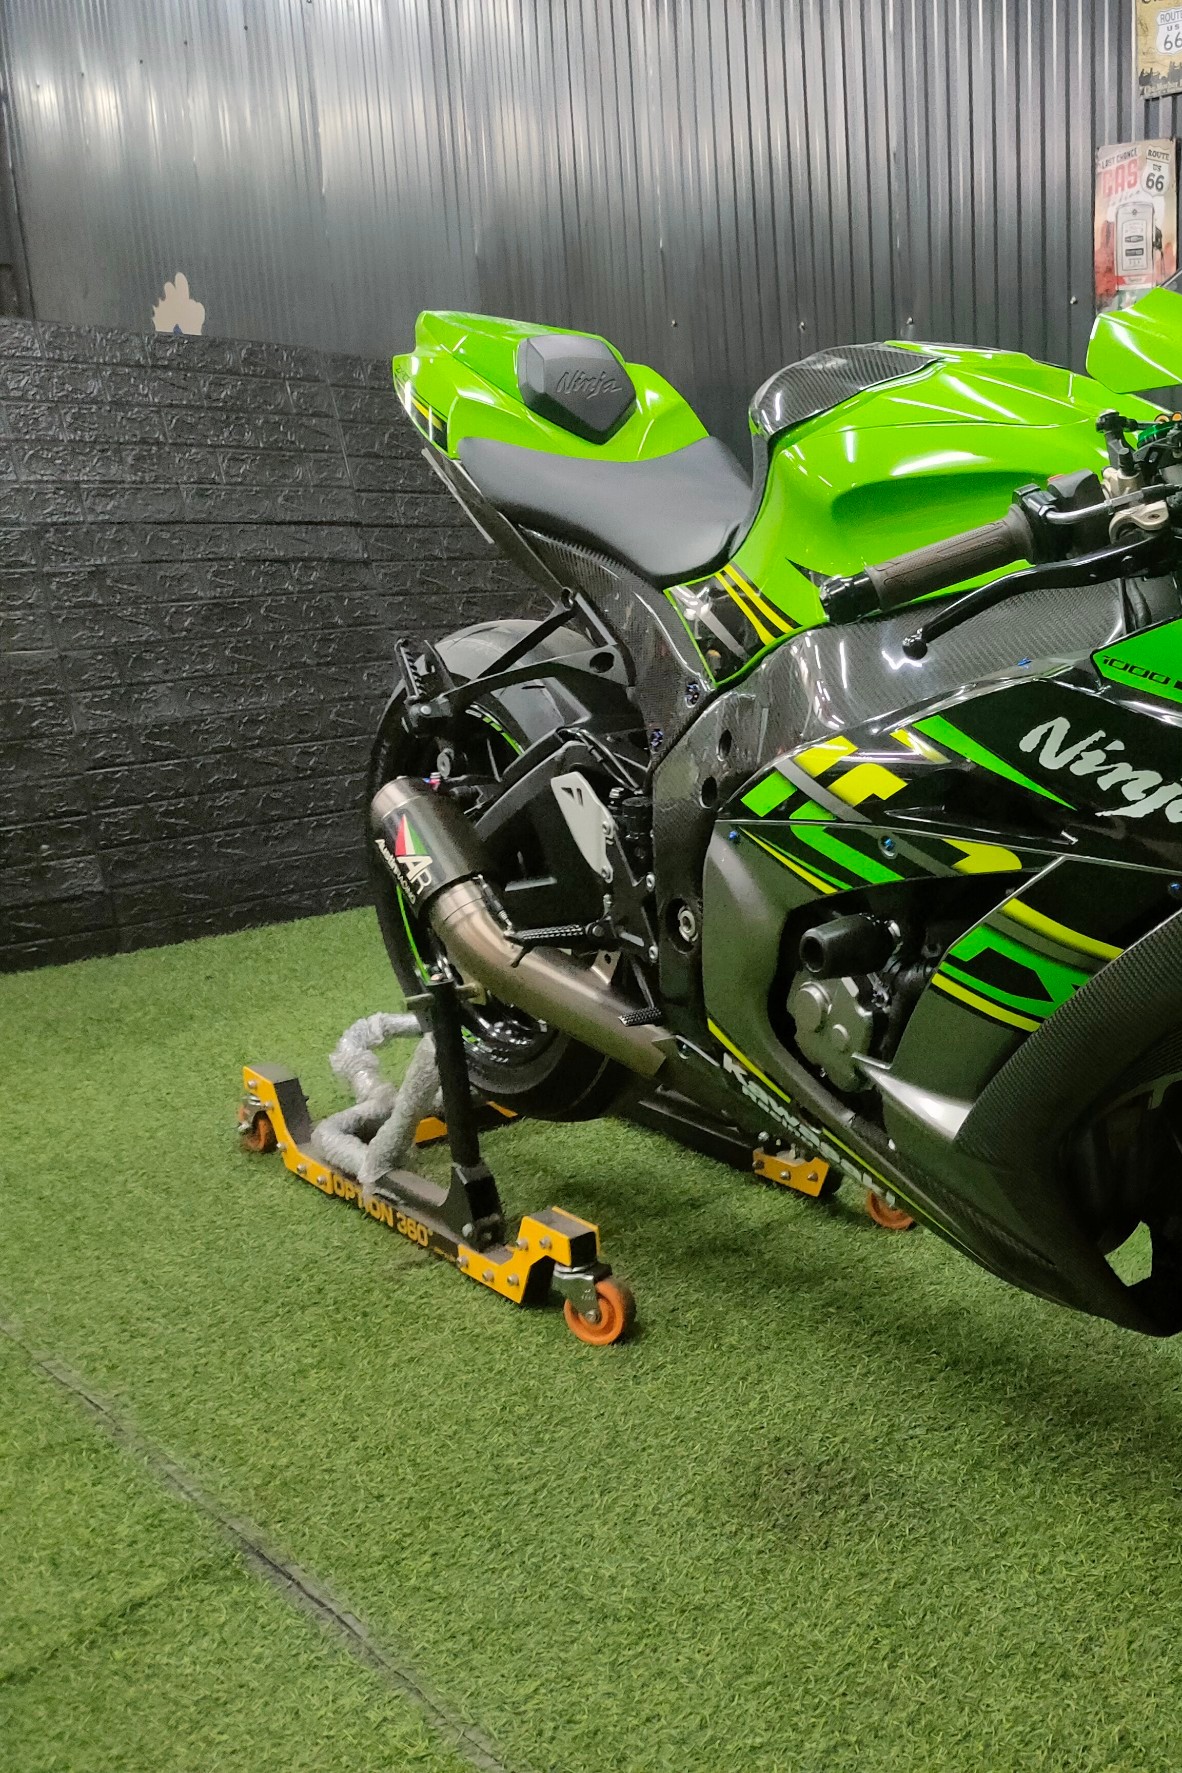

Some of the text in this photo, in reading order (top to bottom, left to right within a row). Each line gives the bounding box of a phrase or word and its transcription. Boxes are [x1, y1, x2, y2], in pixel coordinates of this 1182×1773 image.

[1147, 149, 1170, 161] ROUTE
[1102, 158, 1138, 199] GAS
[1146, 172, 1165, 193] 66
[556, 369, 623, 400] Ninja
[723, 1052, 896, 1208] Kawasaki
